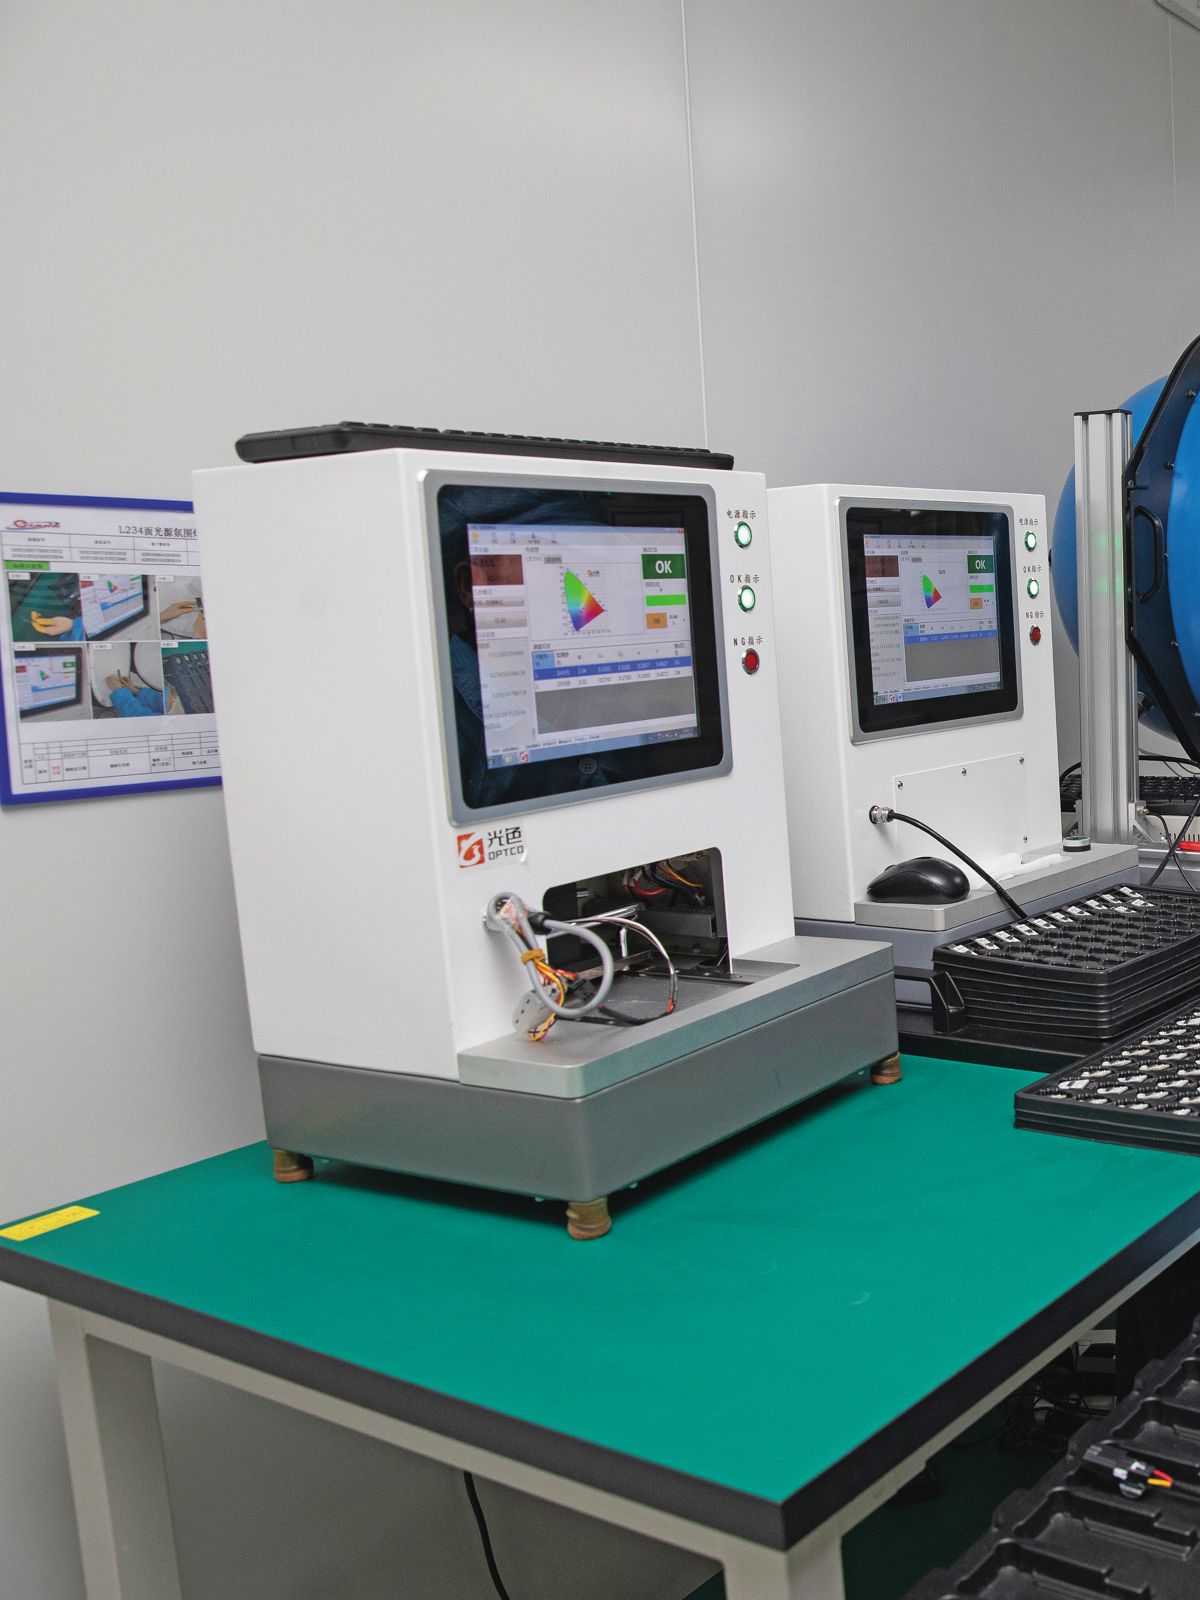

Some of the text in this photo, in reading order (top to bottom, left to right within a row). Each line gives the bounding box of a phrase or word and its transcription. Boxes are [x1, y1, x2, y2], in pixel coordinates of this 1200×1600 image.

[726, 509, 757, 520] 电源指示
[655, 560, 672, 574] OK
[975, 560, 986, 570] OK
[487, 826, 522, 848] 光色
[488, 845, 524, 861] OPTCO
